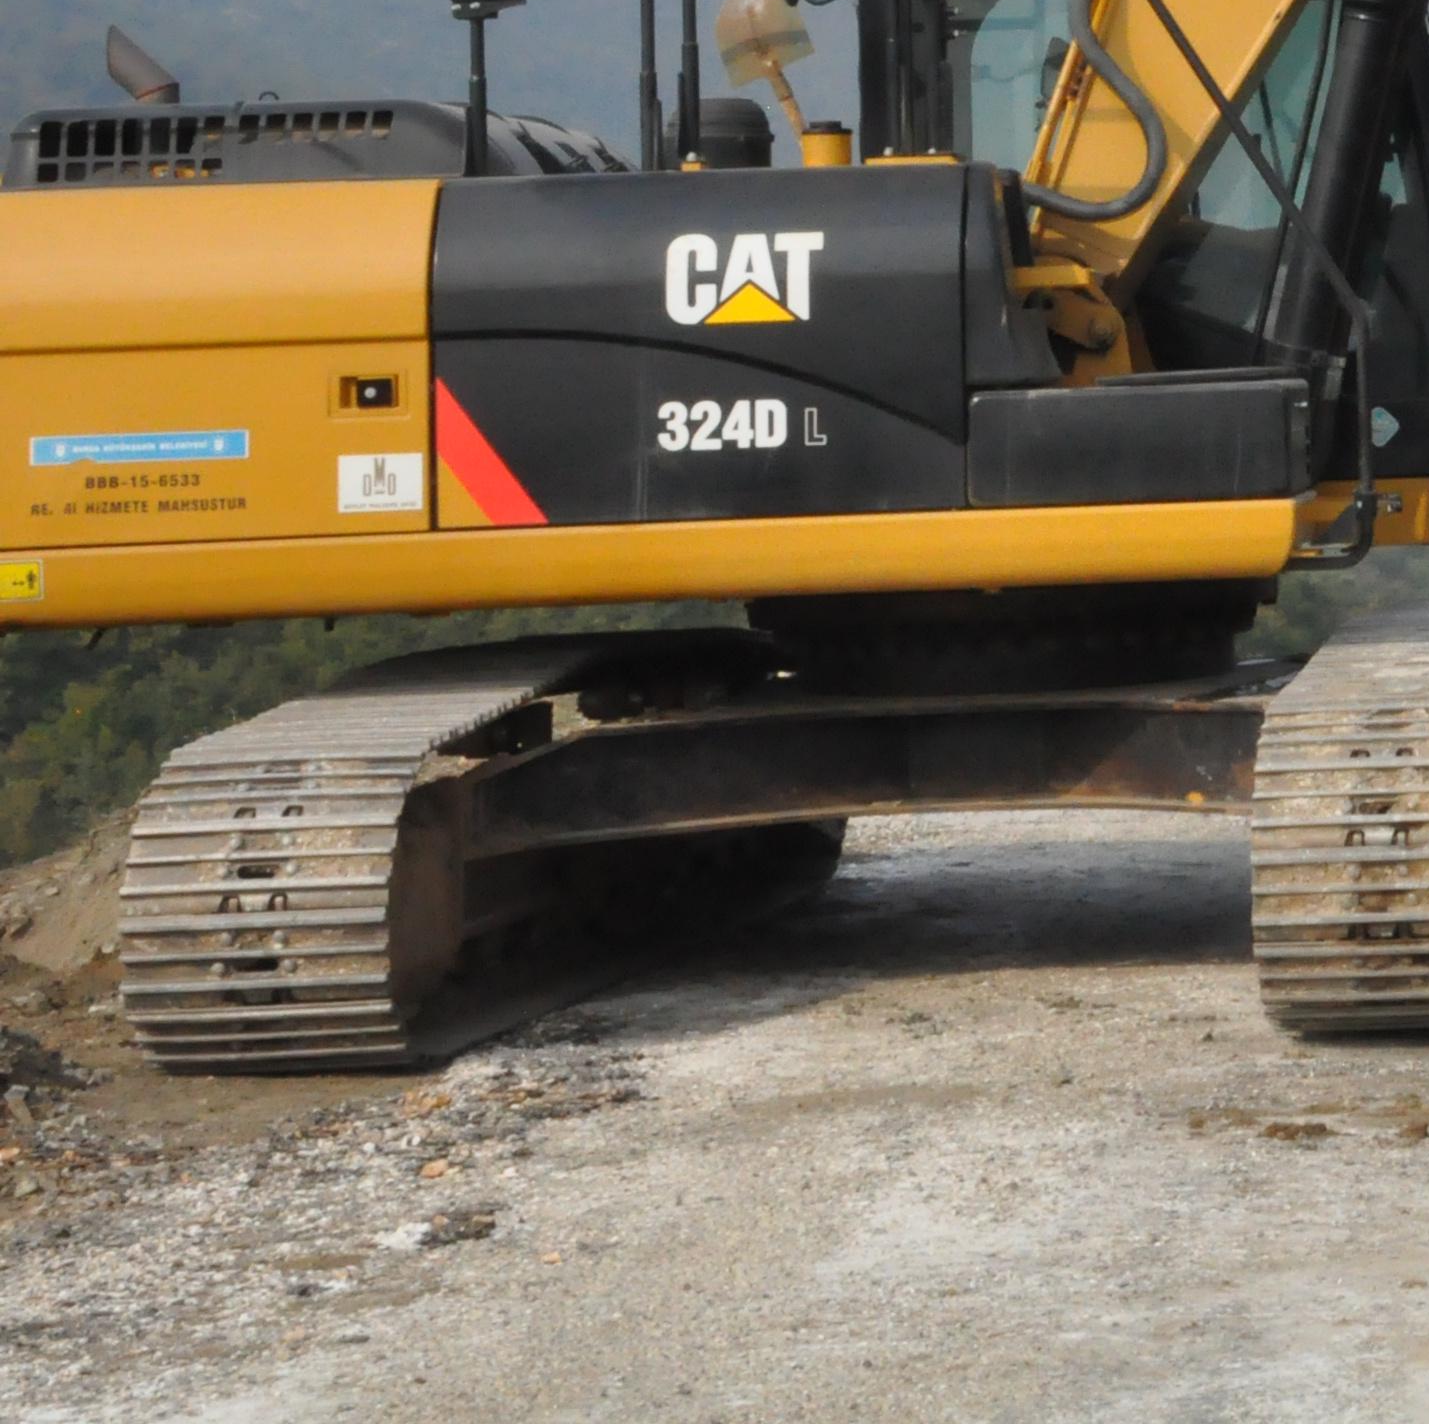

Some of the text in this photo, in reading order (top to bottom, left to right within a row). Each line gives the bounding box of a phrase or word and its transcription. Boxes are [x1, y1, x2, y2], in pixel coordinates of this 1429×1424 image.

[665, 231, 824, 325] CAT
[657, 399, 827, 452] 324D L
